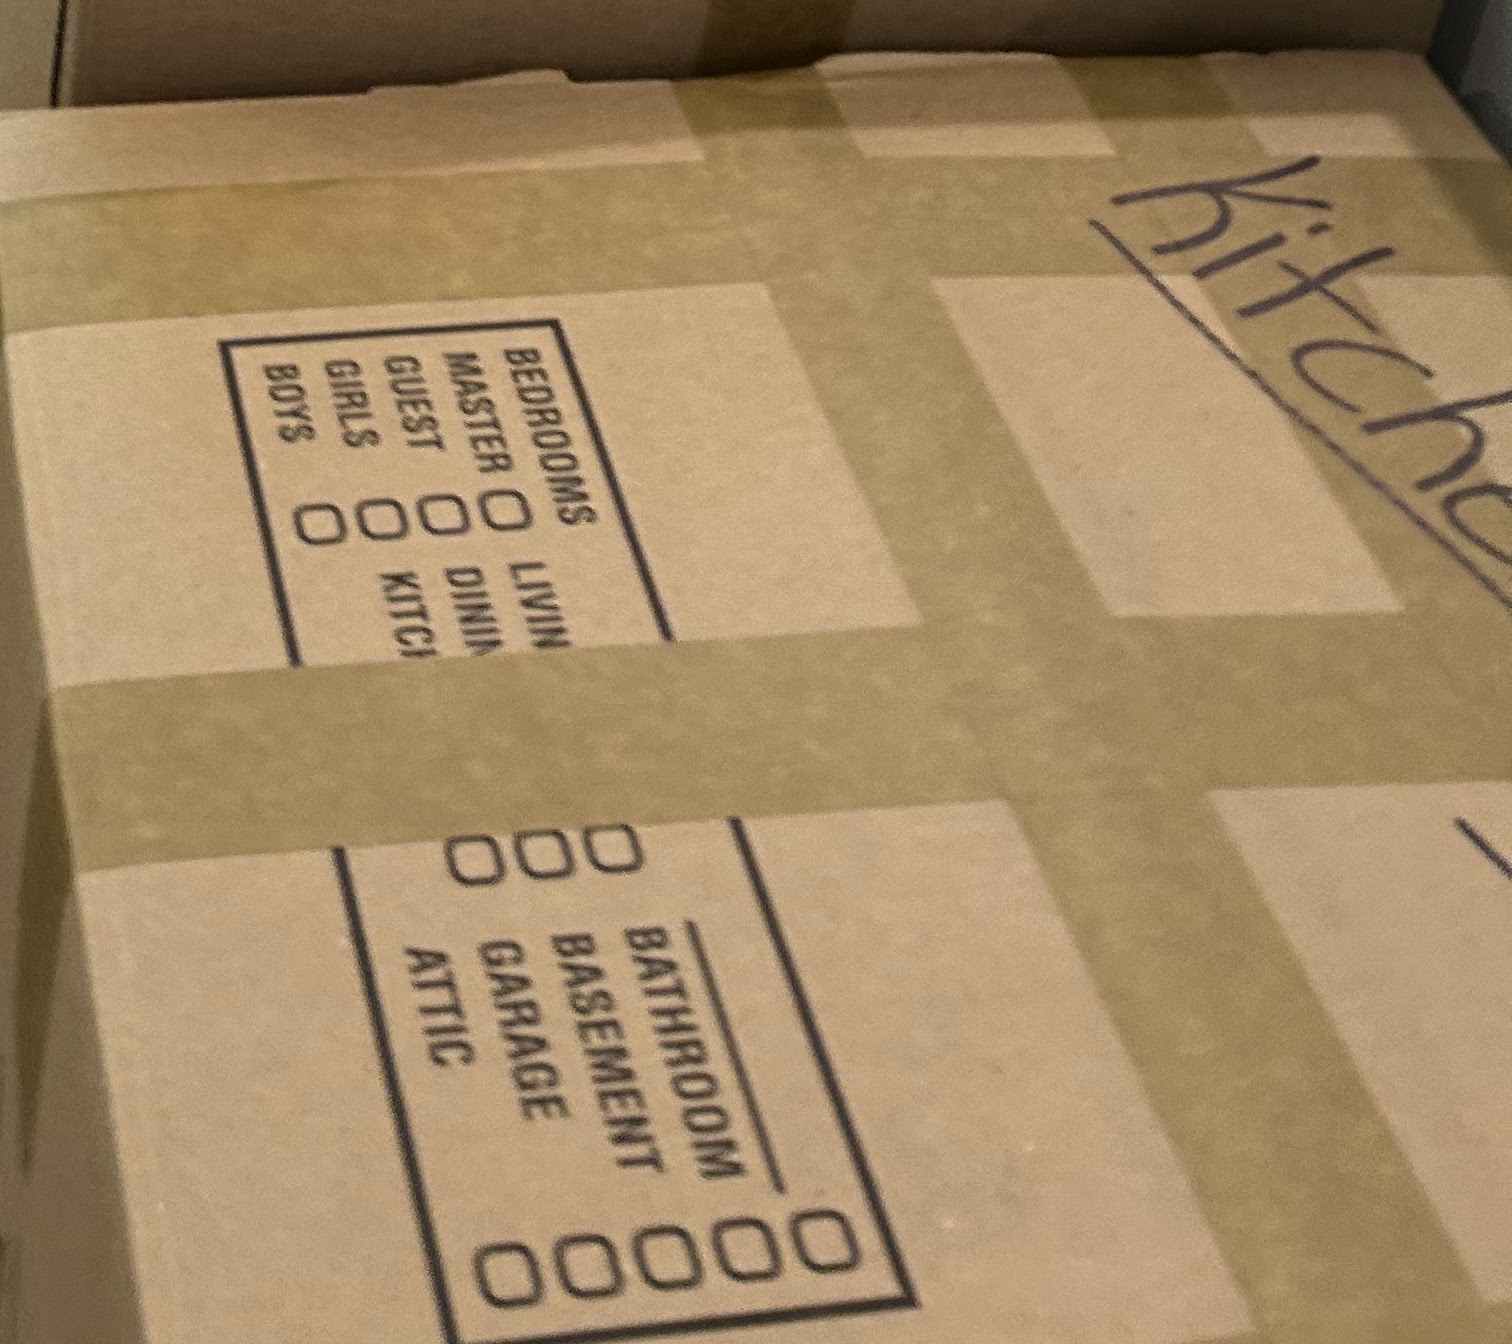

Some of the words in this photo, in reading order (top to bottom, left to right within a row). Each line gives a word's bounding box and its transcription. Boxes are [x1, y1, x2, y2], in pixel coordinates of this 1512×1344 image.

[263, 363, 315, 443] BOYS
[324, 359, 380, 449] GIRLS
[384, 354, 446, 451] GUEST
[443, 351, 513, 474] MASTER
[504, 347, 598, 526] BEDROOMS
[403, 944, 476, 1068] ATTIC
[479, 939, 569, 1122] GARAGE
[550, 932, 666, 1174] BASEMENT
[624, 926, 748, 1180] BATHROOM
